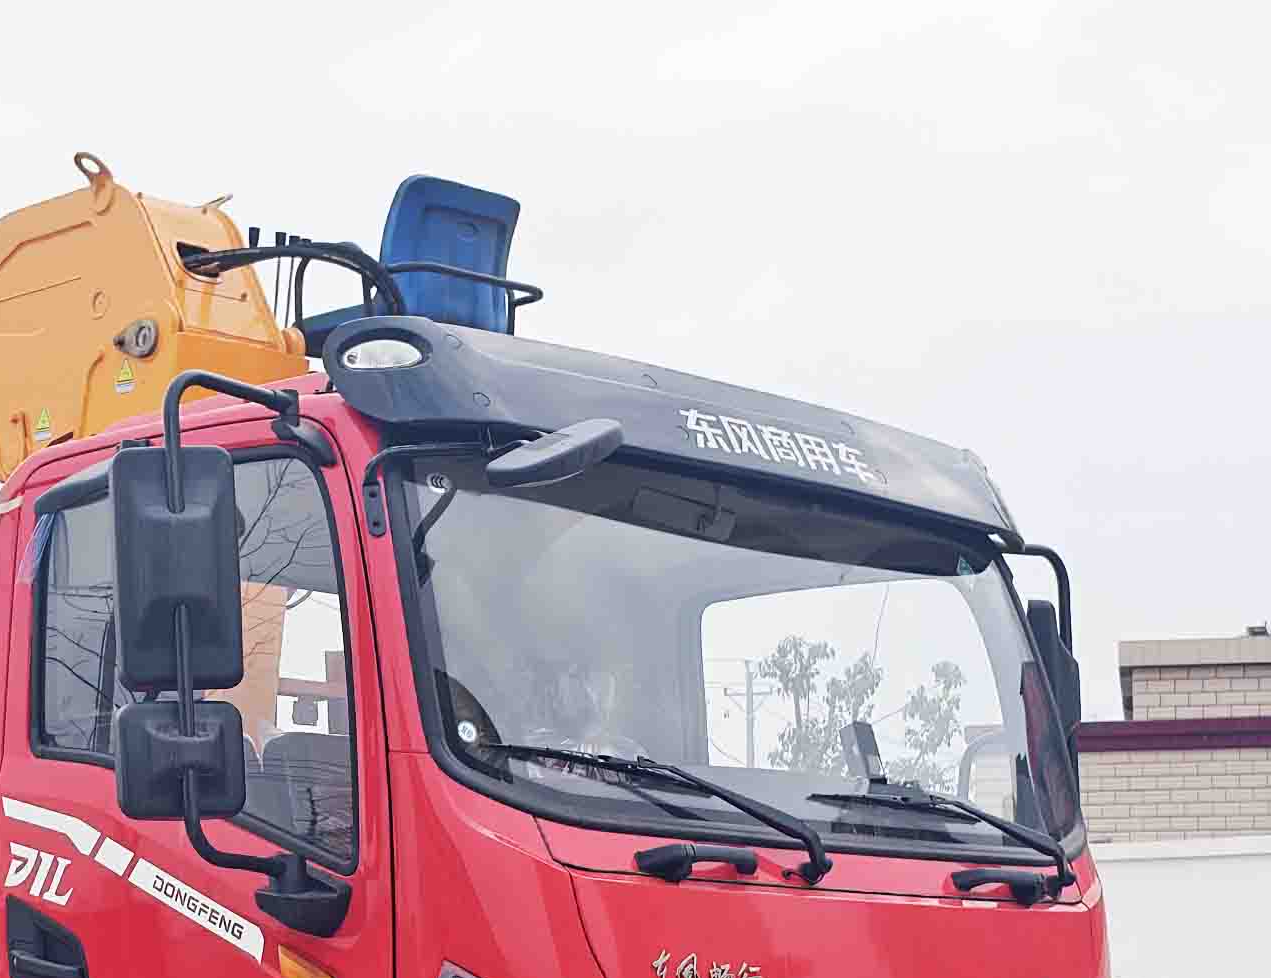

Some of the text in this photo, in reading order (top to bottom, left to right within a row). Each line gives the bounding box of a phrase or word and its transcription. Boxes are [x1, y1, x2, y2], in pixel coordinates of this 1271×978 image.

[679, 408, 874, 482] 东风商用车
[152, 874, 244, 940] DONGFENG
